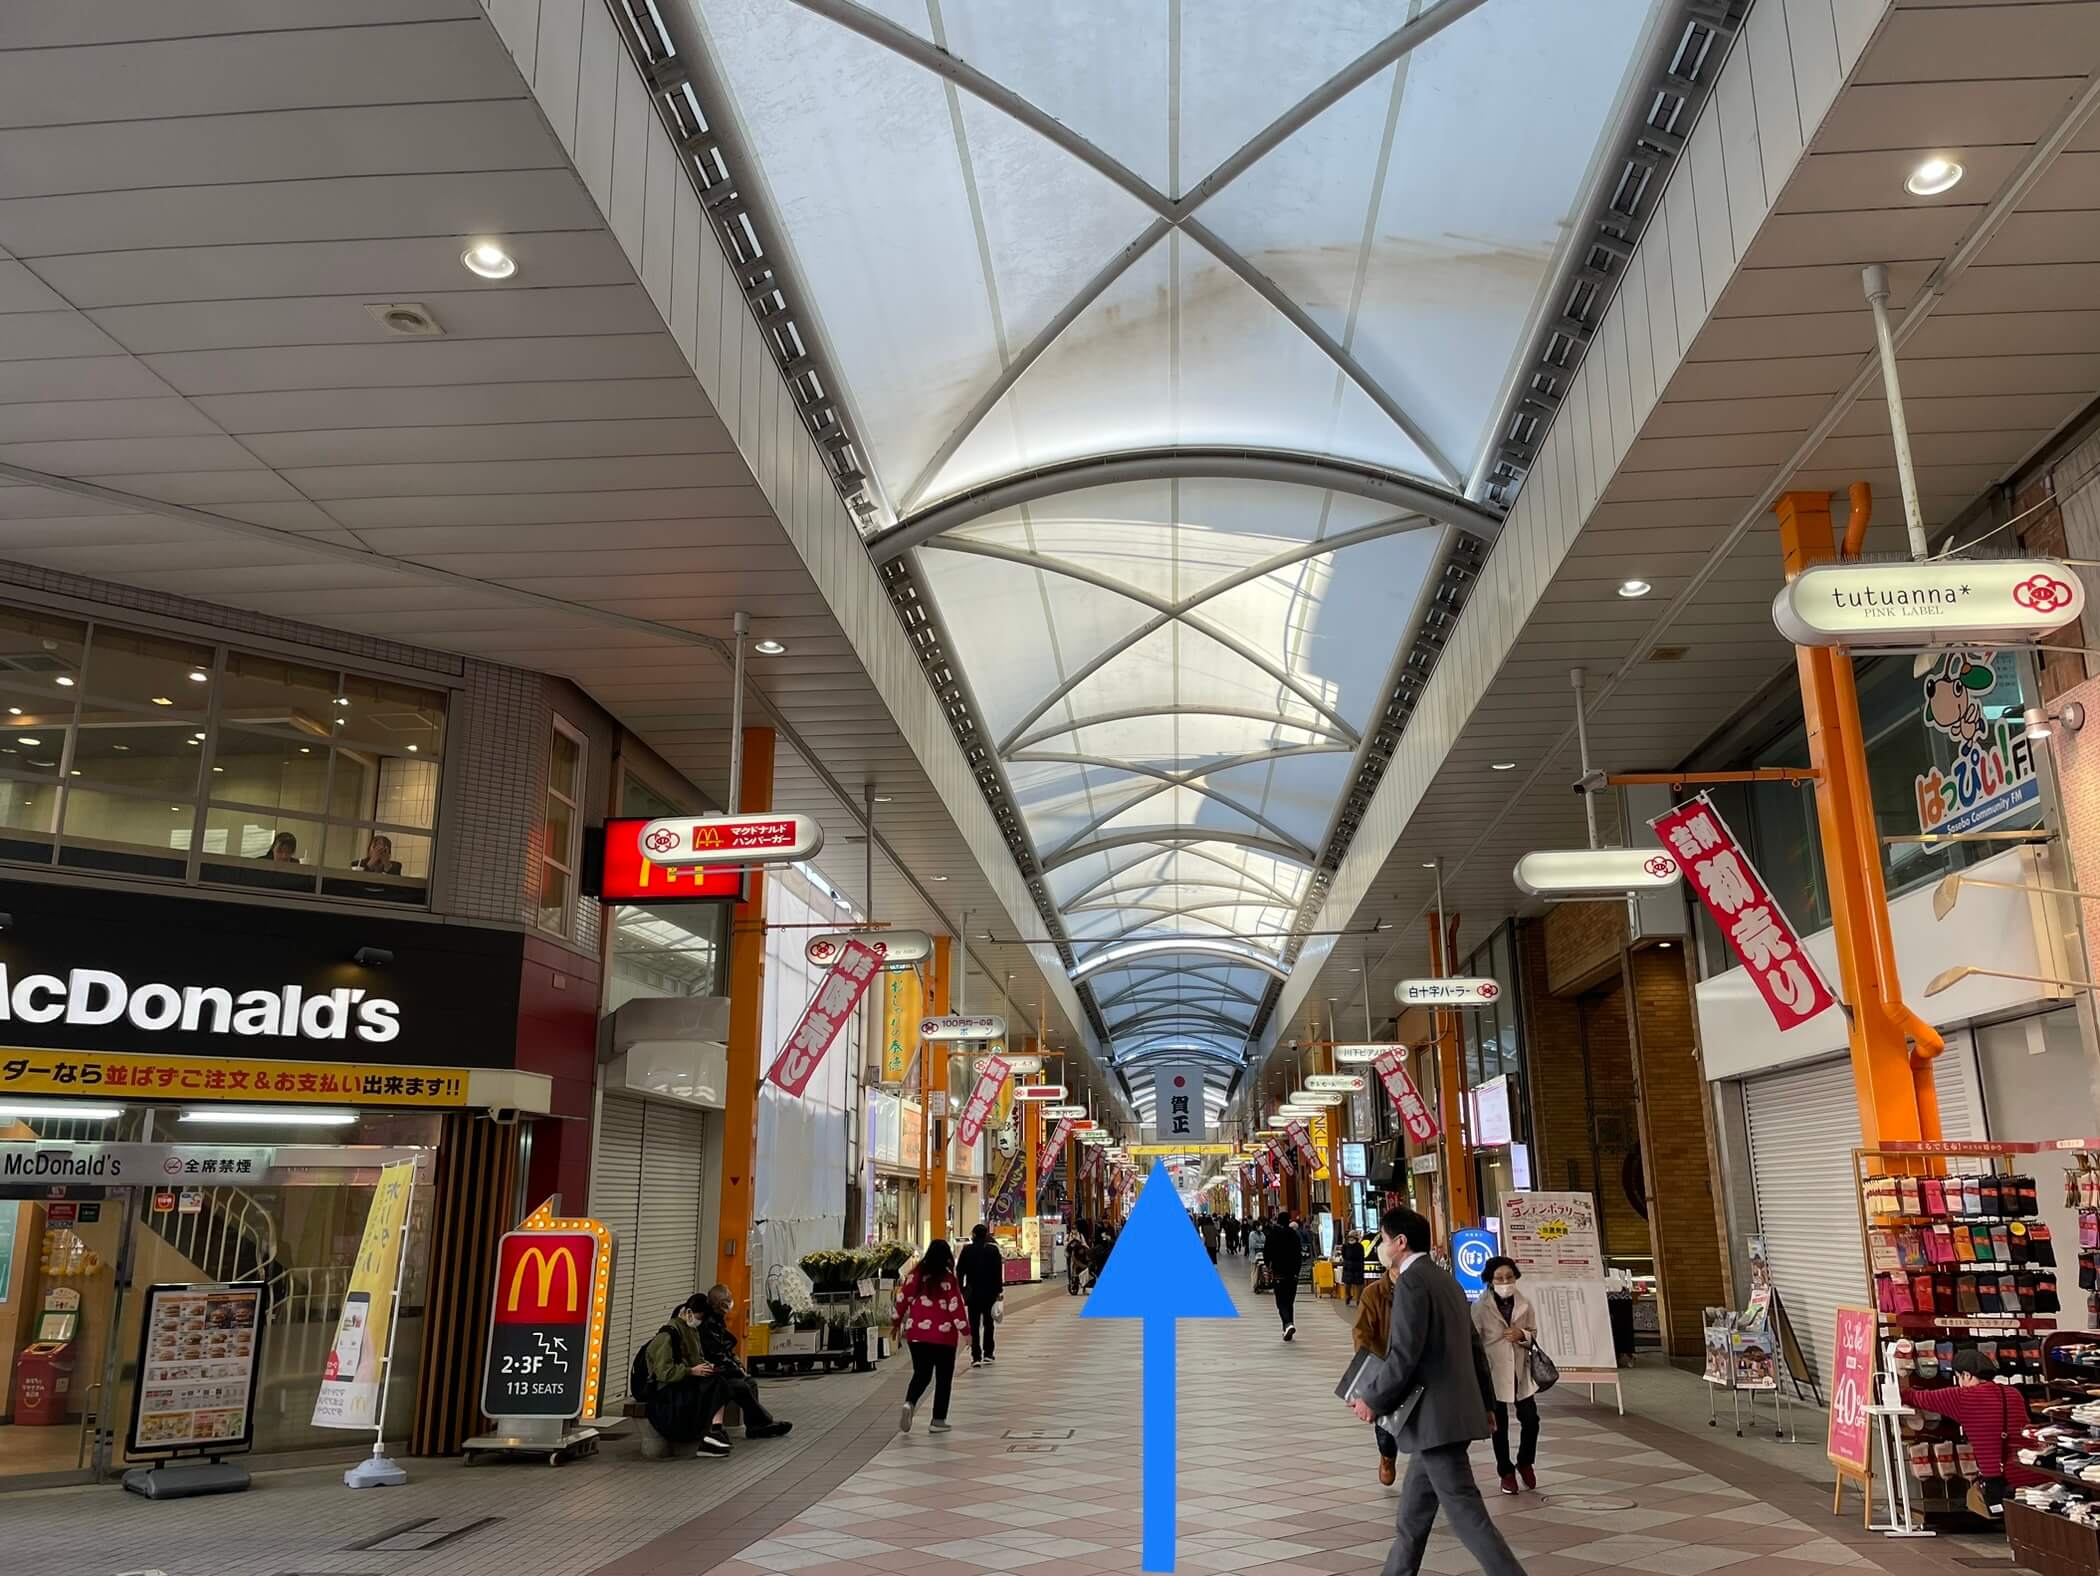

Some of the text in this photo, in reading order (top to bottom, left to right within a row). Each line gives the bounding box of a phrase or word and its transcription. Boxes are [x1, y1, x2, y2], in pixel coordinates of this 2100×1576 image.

[1864, 604, 1944, 617] PINK LABEL
[1947, 789, 2023, 834] Sasebo Community FM
[730, 823, 788, 836] マクドナルド
[732, 834, 792, 847] ハンバーガー
[1171, 1095, 1190, 1134] 賀正
[4, 1153, 121, 1177] McDonald's
[184, 1159, 253, 1175] 全席禁煙
[506, 1382, 564, 1395] 113 SEATS
